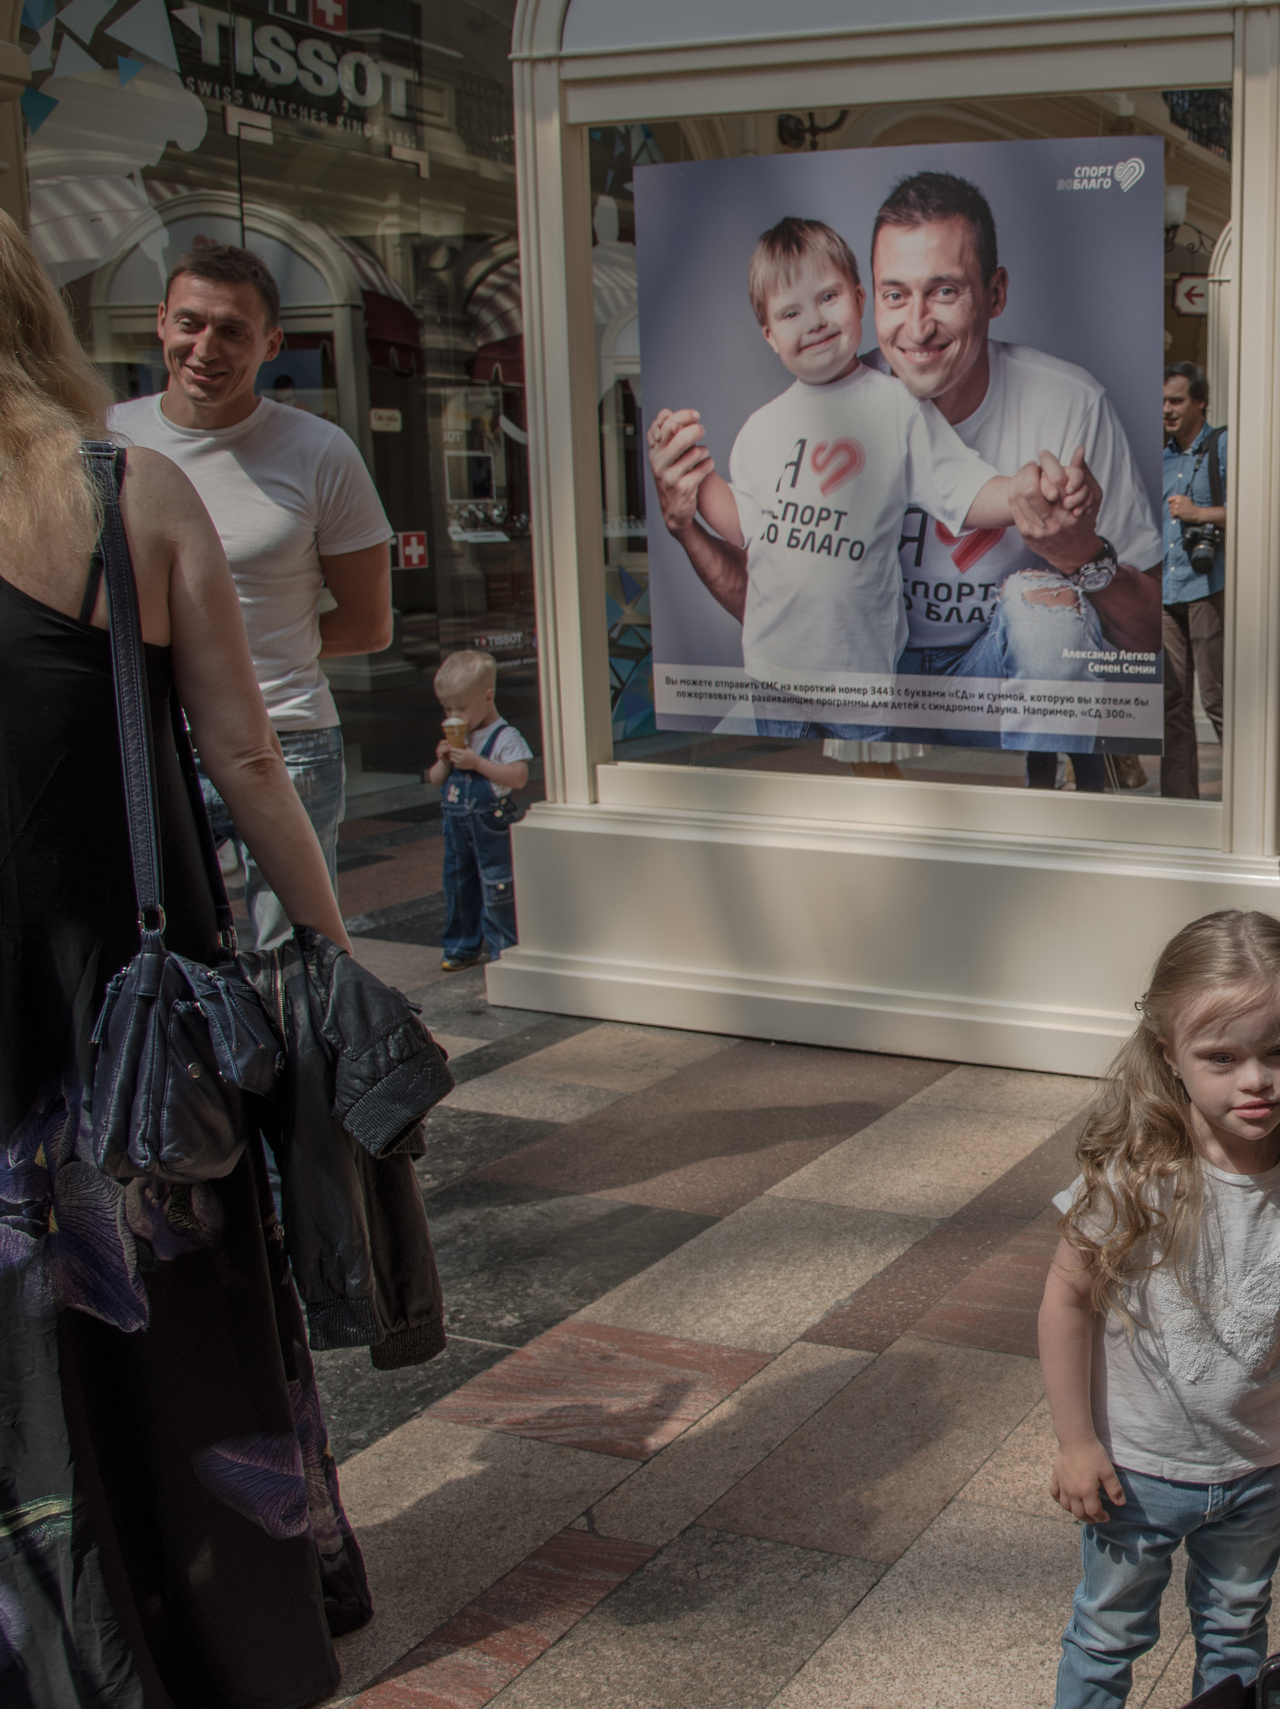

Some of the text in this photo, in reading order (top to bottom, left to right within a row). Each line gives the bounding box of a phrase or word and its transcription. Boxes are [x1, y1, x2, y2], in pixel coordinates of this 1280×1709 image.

[186, 3, 418, 118] TISSOT
[186, 77, 243, 105] SWISS
[251, 93, 328, 127] WATCHES
[336, 115, 381, 140] SINCE
[1074, 166, 1114, 178] СПОРТ
[786, 527, 865, 561] БЛАГО
[903, 578, 996, 603] ПОРТ
[488, 632, 523, 646] TISSOT
[1062, 649, 1156, 662] Александр Легков
[1088, 662, 1156, 675] Семен Семин
[665, 676, 678, 686] Вы
[680, 678, 712, 688] можете
[715, 680, 759, 691] отправить
[761, 682, 778, 691] СМС
[780, 684, 791, 692] на
[793, 683, 836, 695] короткий
[838, 686, 868, 697] номер
[870, 686, 895, 696] 3443
[904, 687, 946, 700] буквами
[948, 689, 975, 701] «СД»
[986, 690, 1028, 703] суммой,
[1030, 693, 1075, 706] которую
[1077, 696, 1092, 705] вы
[1094, 697, 1131, 706] хотели
[1133, 696, 1149, 707] бы
[676, 690, 737, 702] пожертвовать
[739, 693, 749, 701] на
[751, 694, 814, 706] развивающие
[816, 697, 869, 709] программы
[871, 700, 888, 710] для
[890, 699, 919, 711] детей
[928, 703, 984, 714] синдромом
[986, 704, 1021, 717] Дауна.
[1023, 706, 1078, 719] Например,
